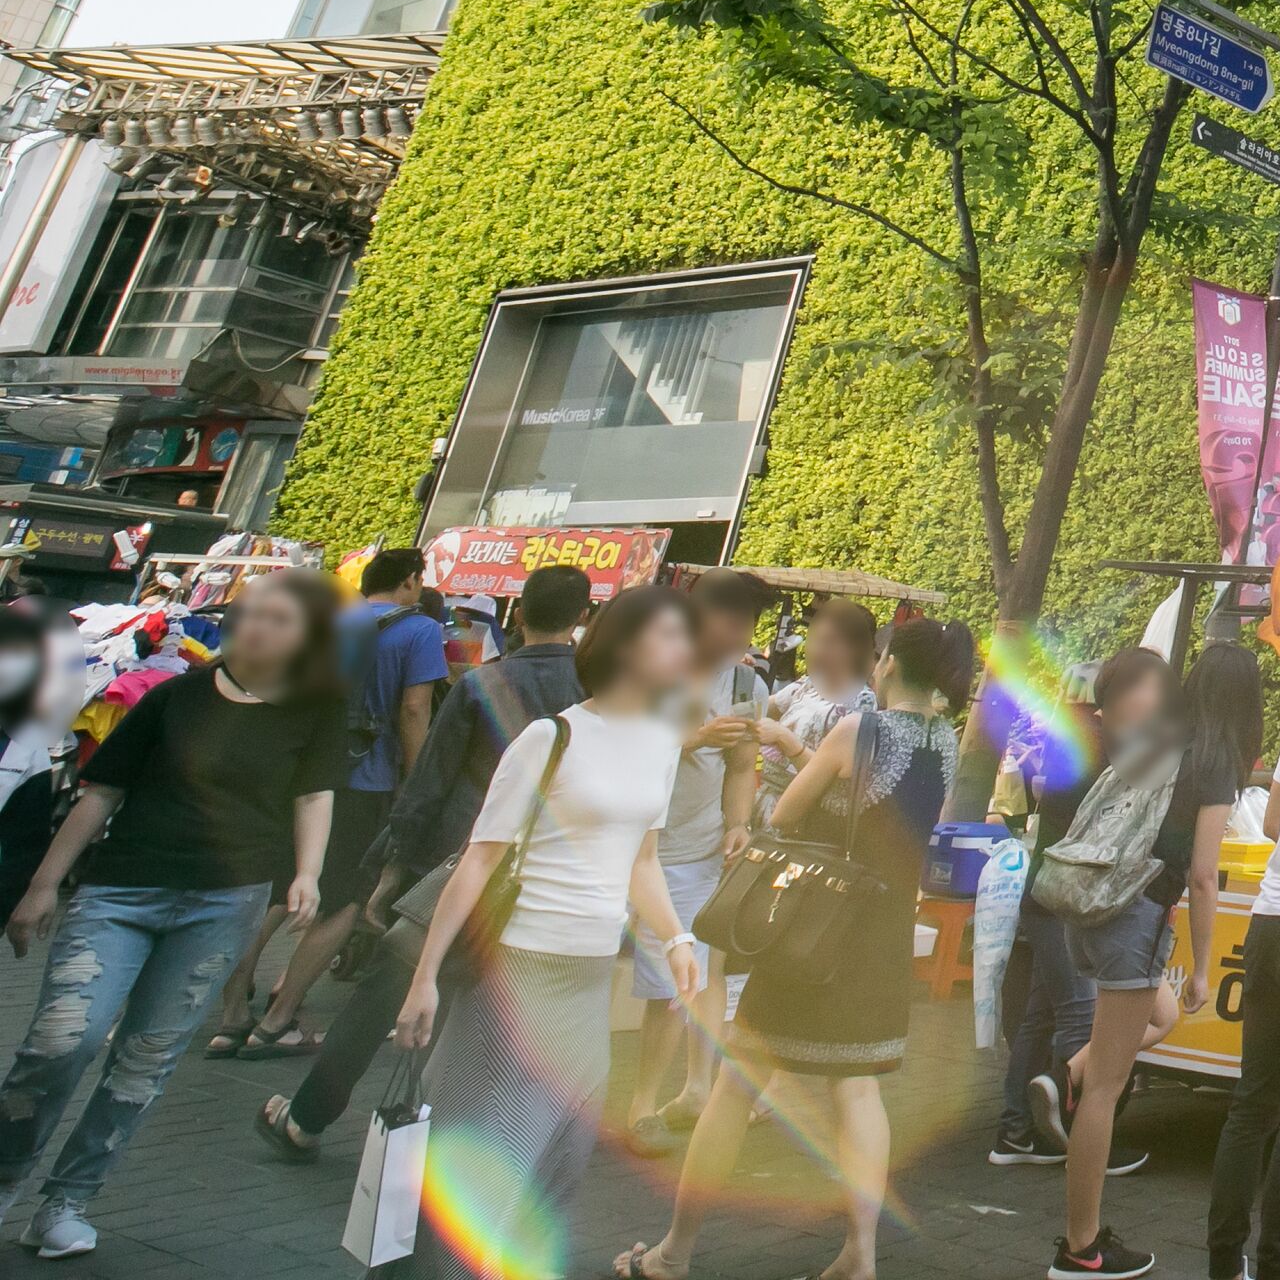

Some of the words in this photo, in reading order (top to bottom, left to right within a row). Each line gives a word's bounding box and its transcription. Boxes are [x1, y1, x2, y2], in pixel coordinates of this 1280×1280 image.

[1160, 10, 1223, 58] 명동8나길
[1155, 33, 1219, 77] Myeongdong
[1221, 65, 1255, 92] 8na-gil
[521, 407, 591, 426] MusicKorea
